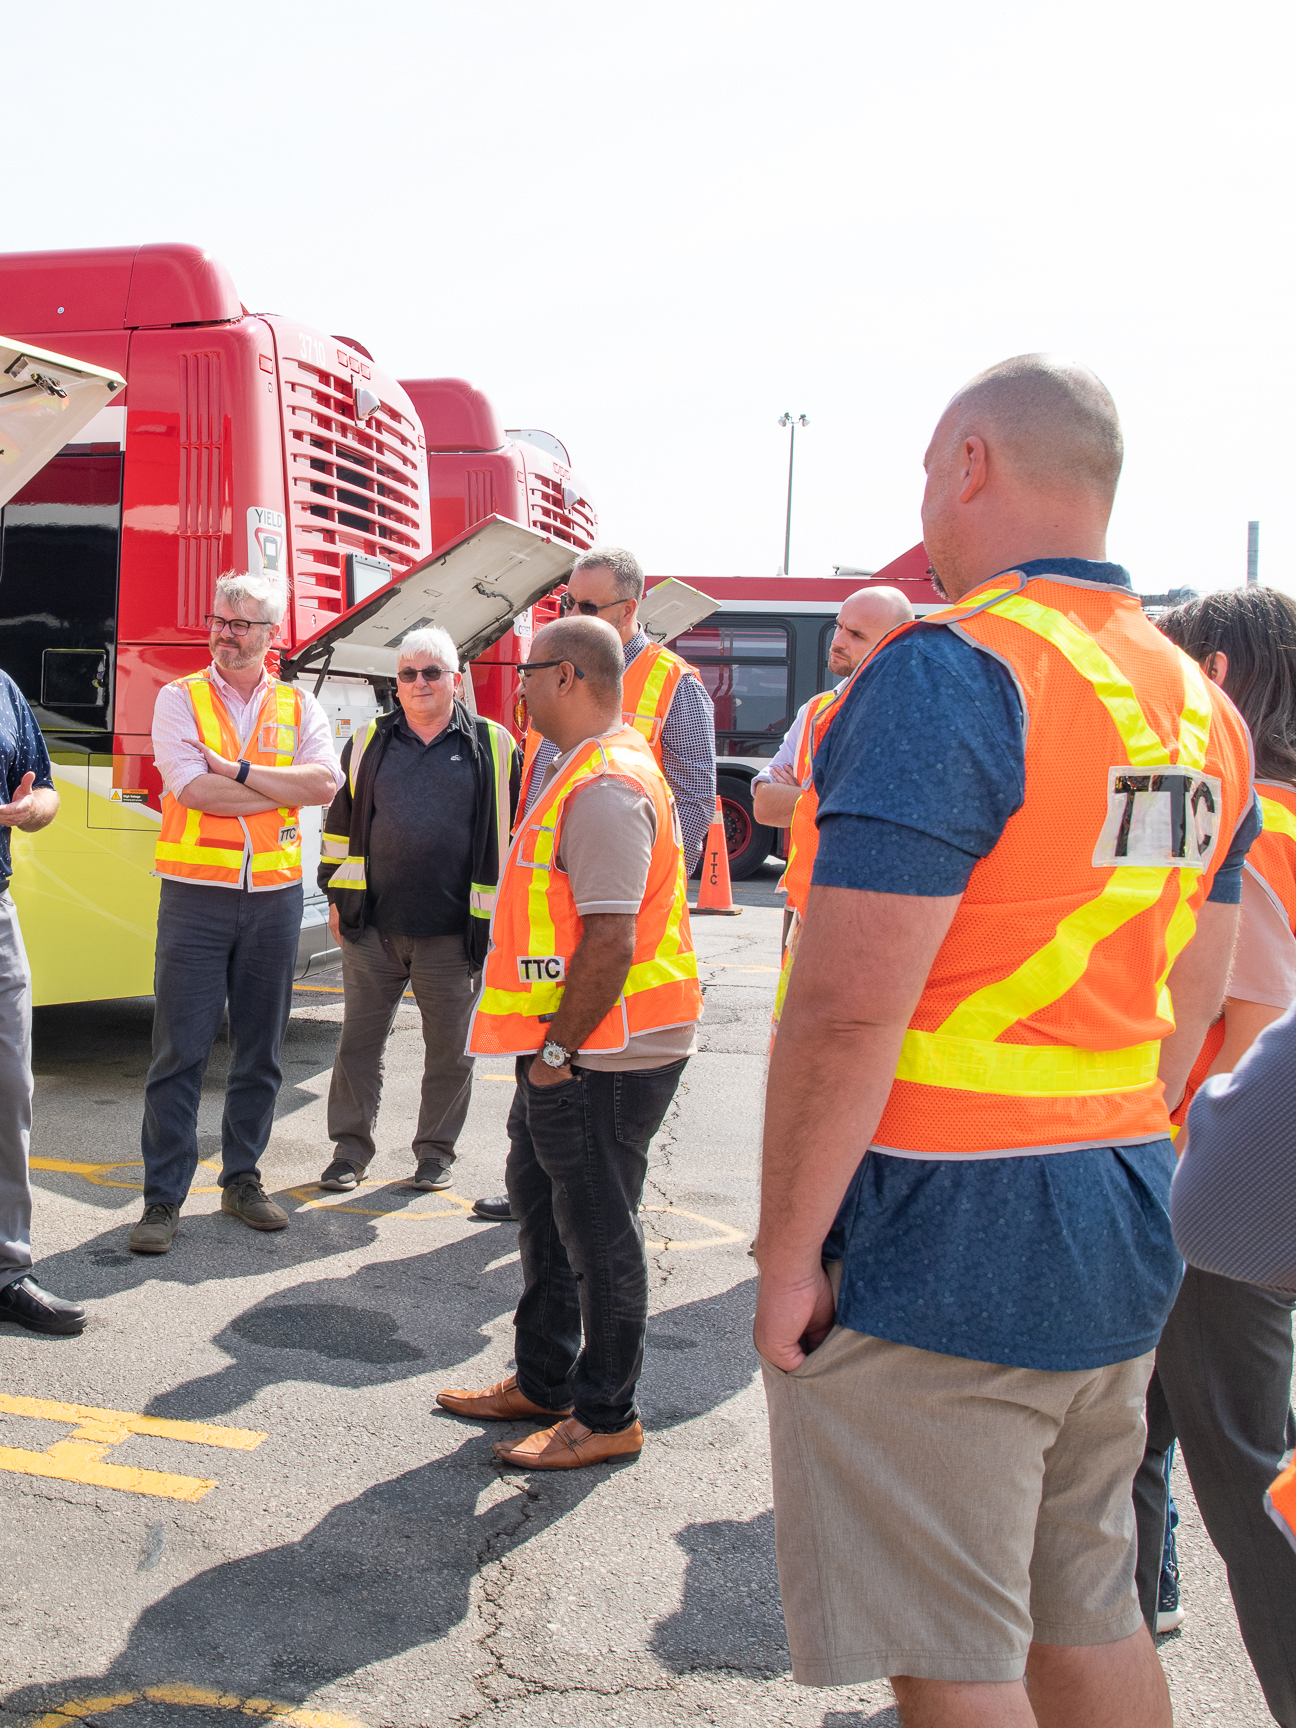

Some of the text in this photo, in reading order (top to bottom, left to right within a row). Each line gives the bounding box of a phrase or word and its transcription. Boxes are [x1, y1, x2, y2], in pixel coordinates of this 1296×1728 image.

[298, 332, 326, 367] 3710
[255, 508, 283, 528] YIELD
[1114, 774, 1216, 858] TTC
[280, 827, 296, 841] TTC
[710, 852, 719, 885] TTC
[520, 958, 561, 980] TTC
